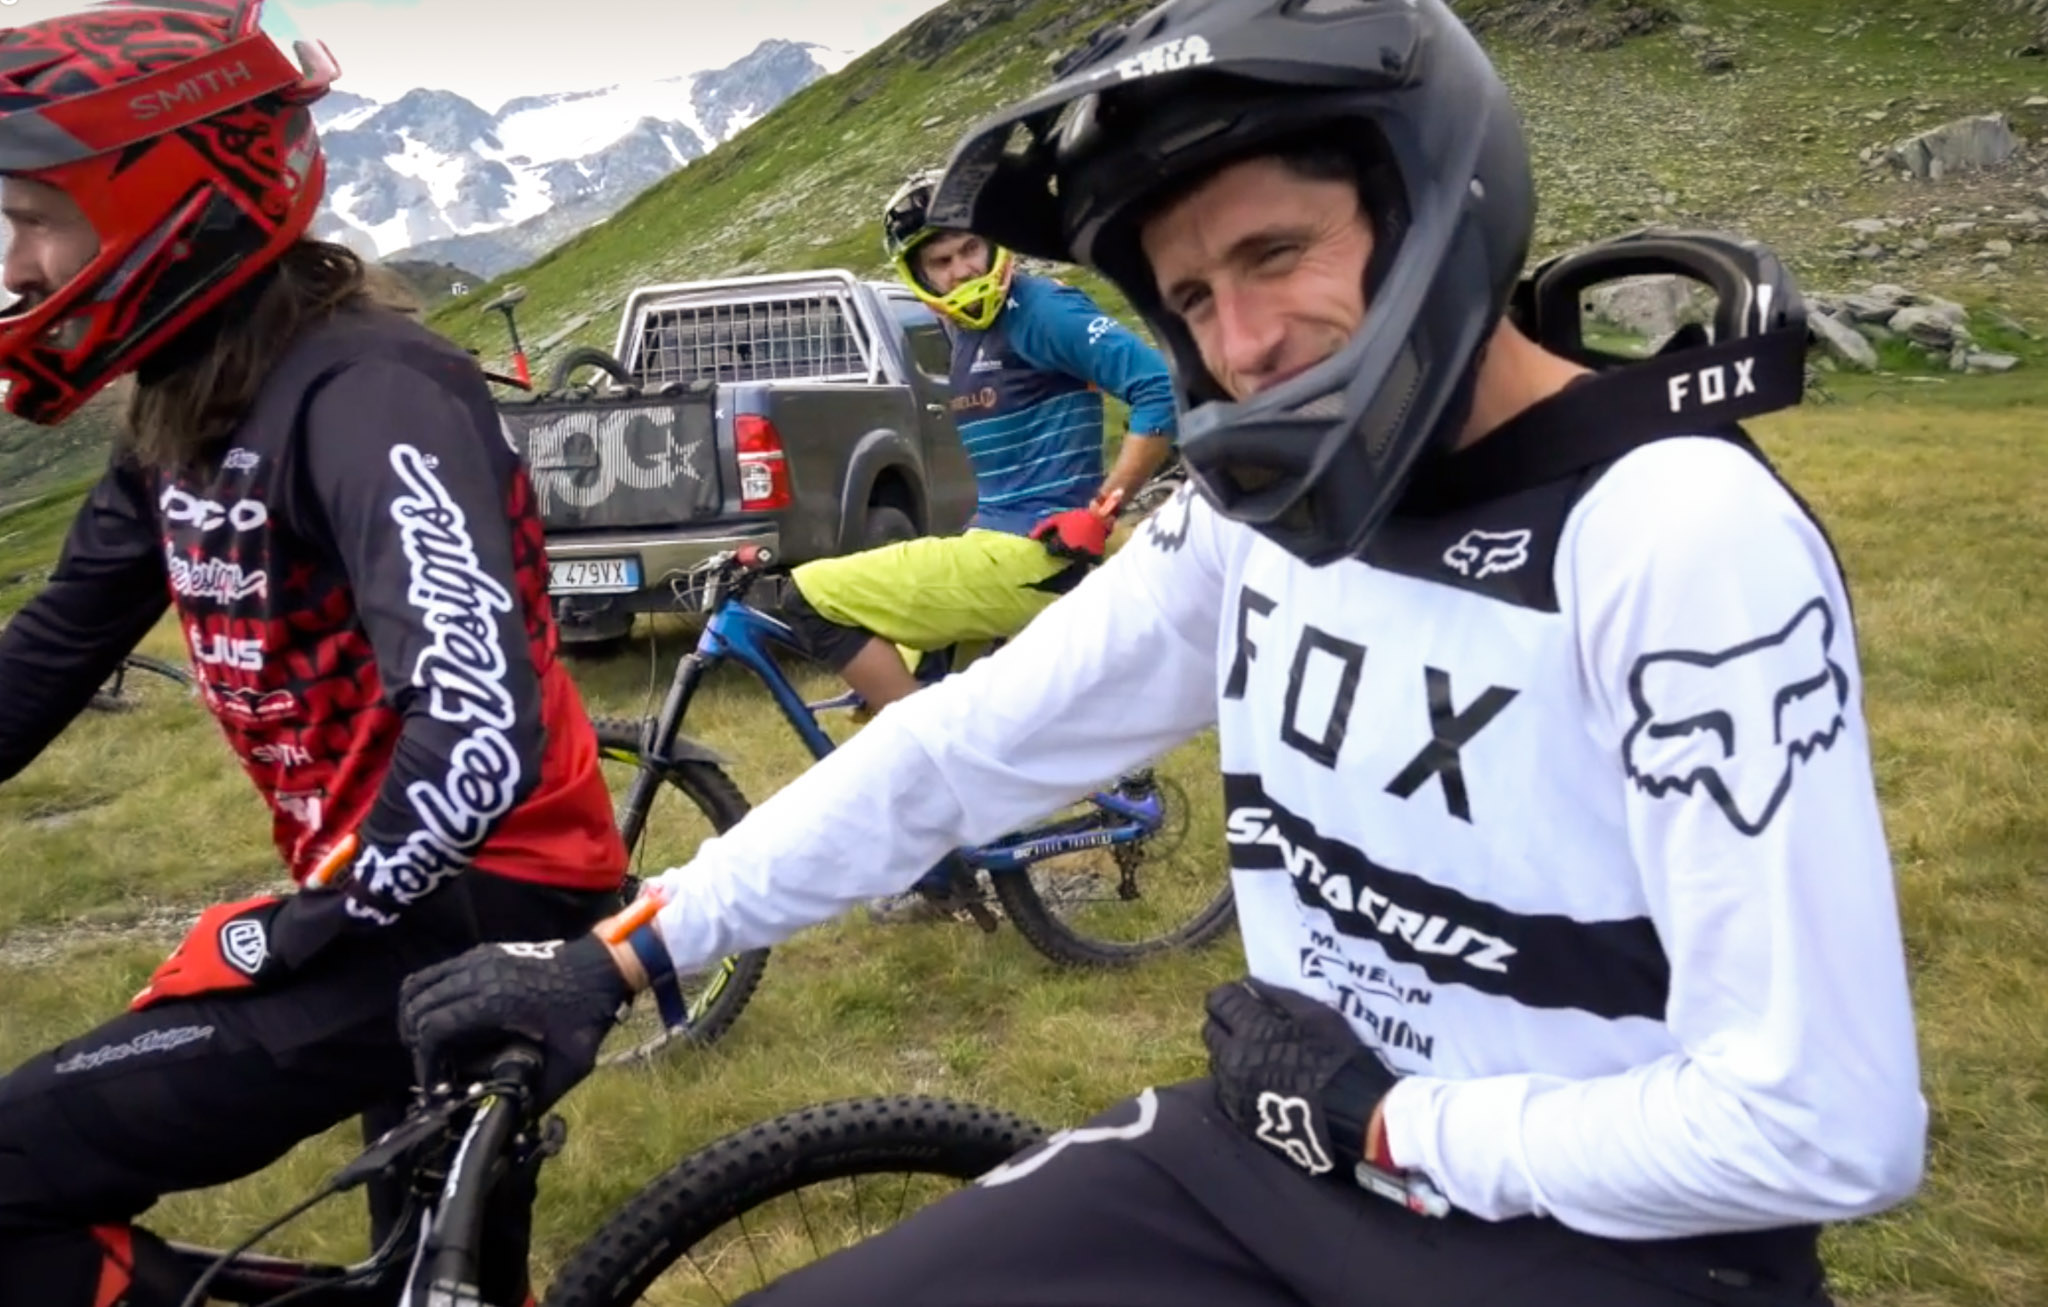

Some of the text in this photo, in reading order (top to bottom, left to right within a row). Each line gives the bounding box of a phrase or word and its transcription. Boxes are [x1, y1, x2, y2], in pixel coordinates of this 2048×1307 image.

[128, 60, 252, 120] SMITH
[1668, 357, 1756, 413] FOX
[390, 443, 516, 730] Designs
[566, 560, 625, 585] 479VX
[1223, 584, 1522, 826] FOX
